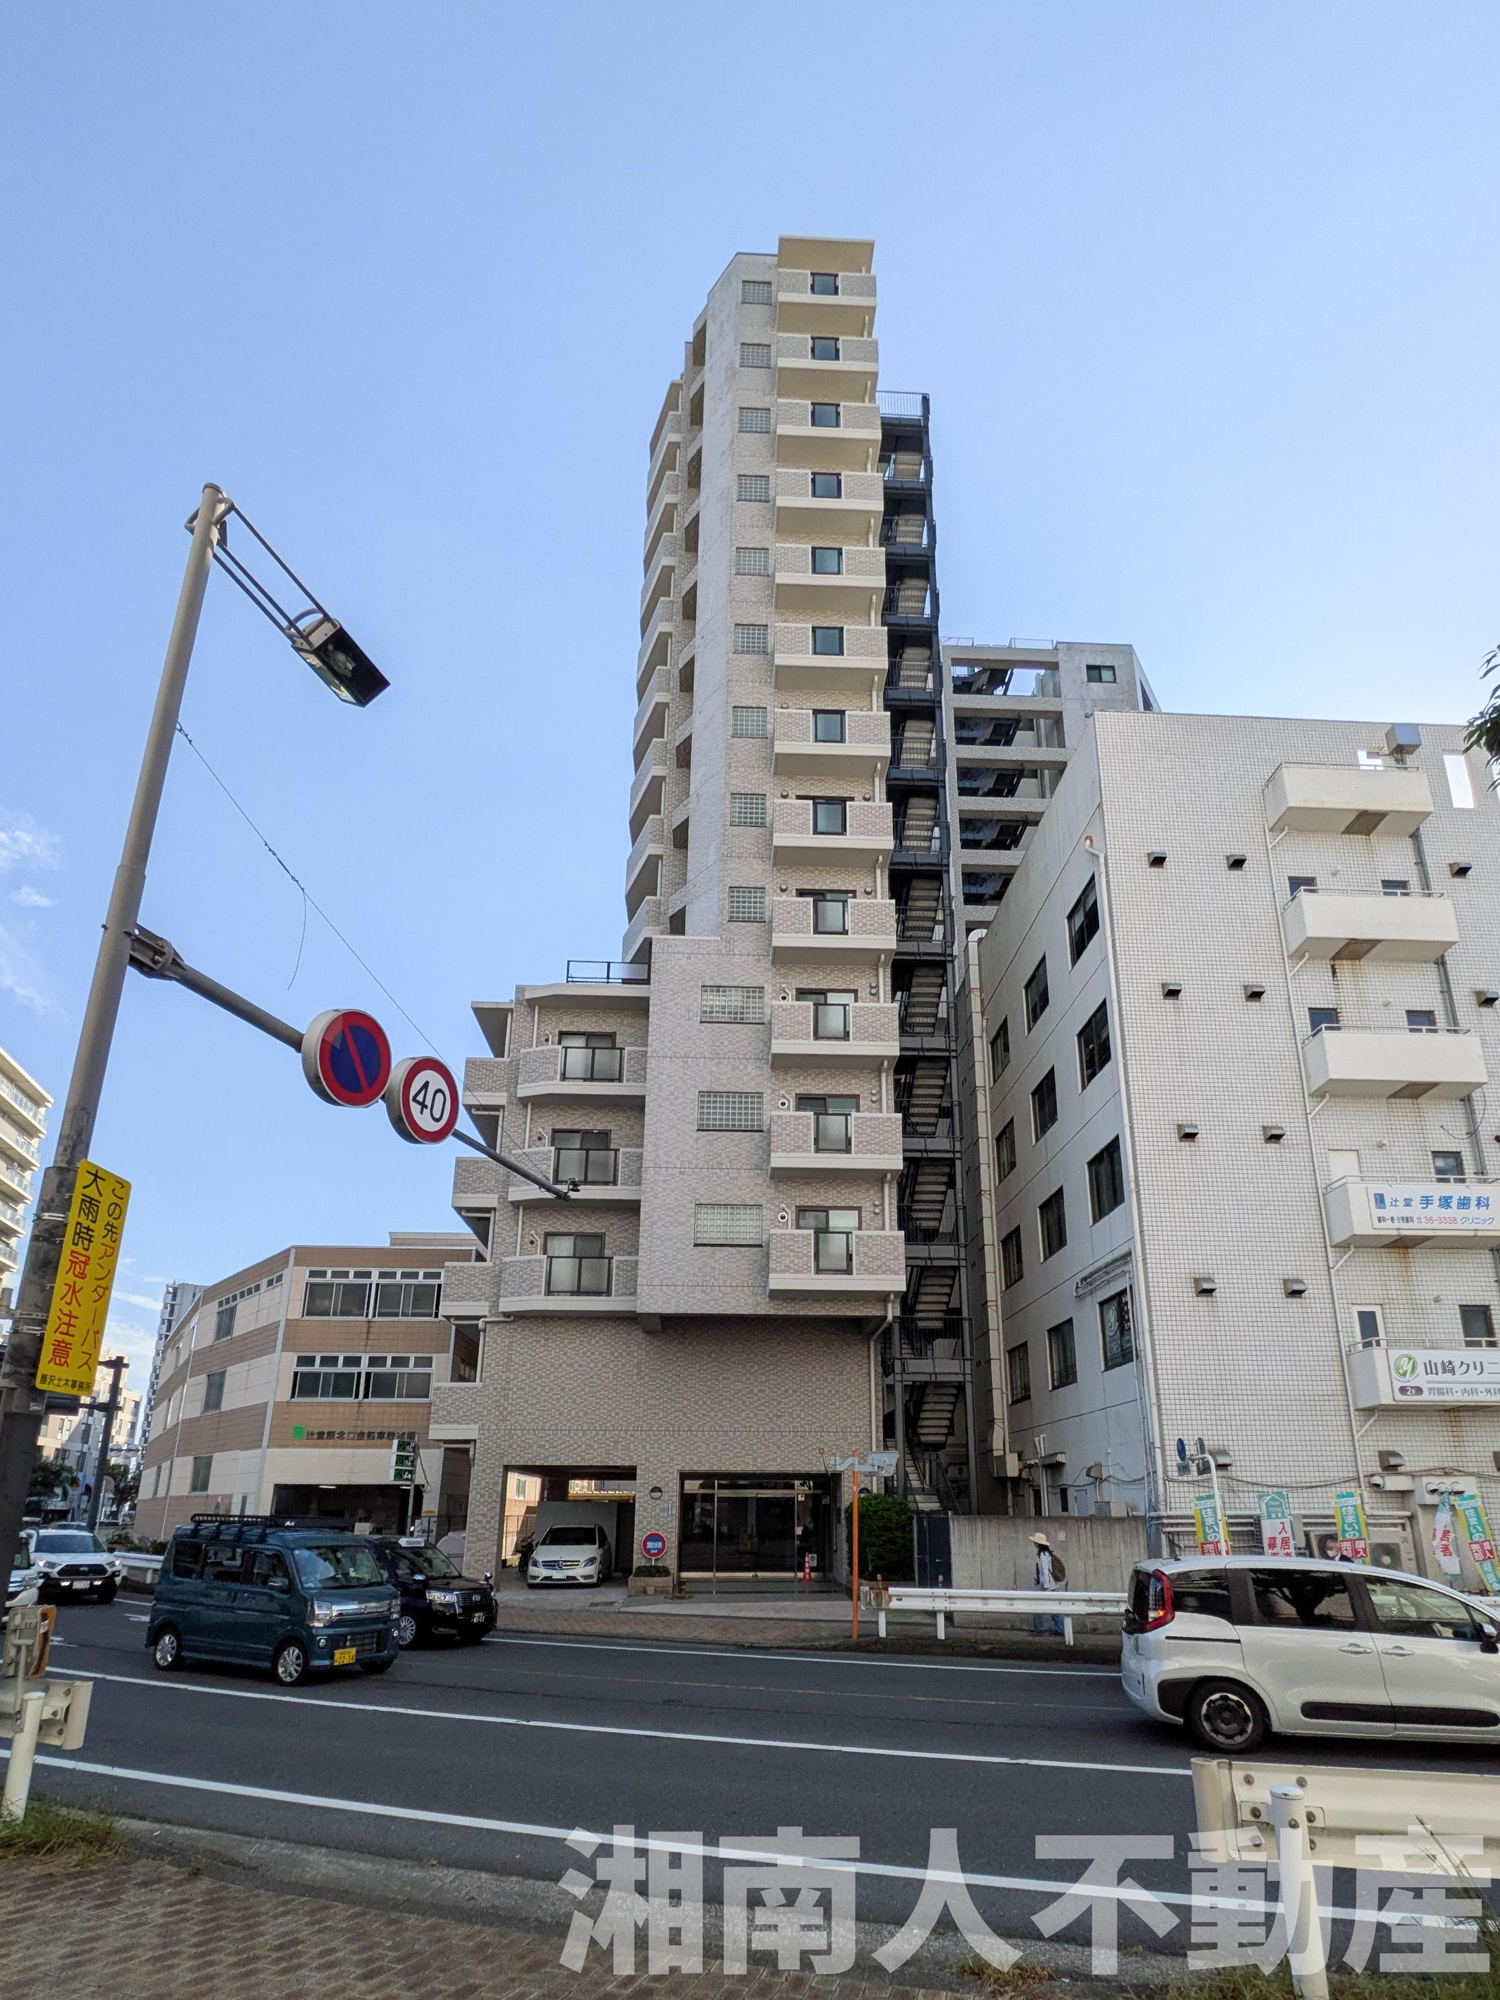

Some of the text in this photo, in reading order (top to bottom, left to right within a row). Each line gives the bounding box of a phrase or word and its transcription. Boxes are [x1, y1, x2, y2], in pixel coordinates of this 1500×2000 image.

[412, 1080, 446, 1122] 40
[1419, 1195, 1490, 1210] 手塚歯科
[1460, 1217, 1495, 1225] クリニック
[47, 1168, 107, 1368] 大雨時冠水注意
[77, 1180, 125, 1372] この先アンダーパス
